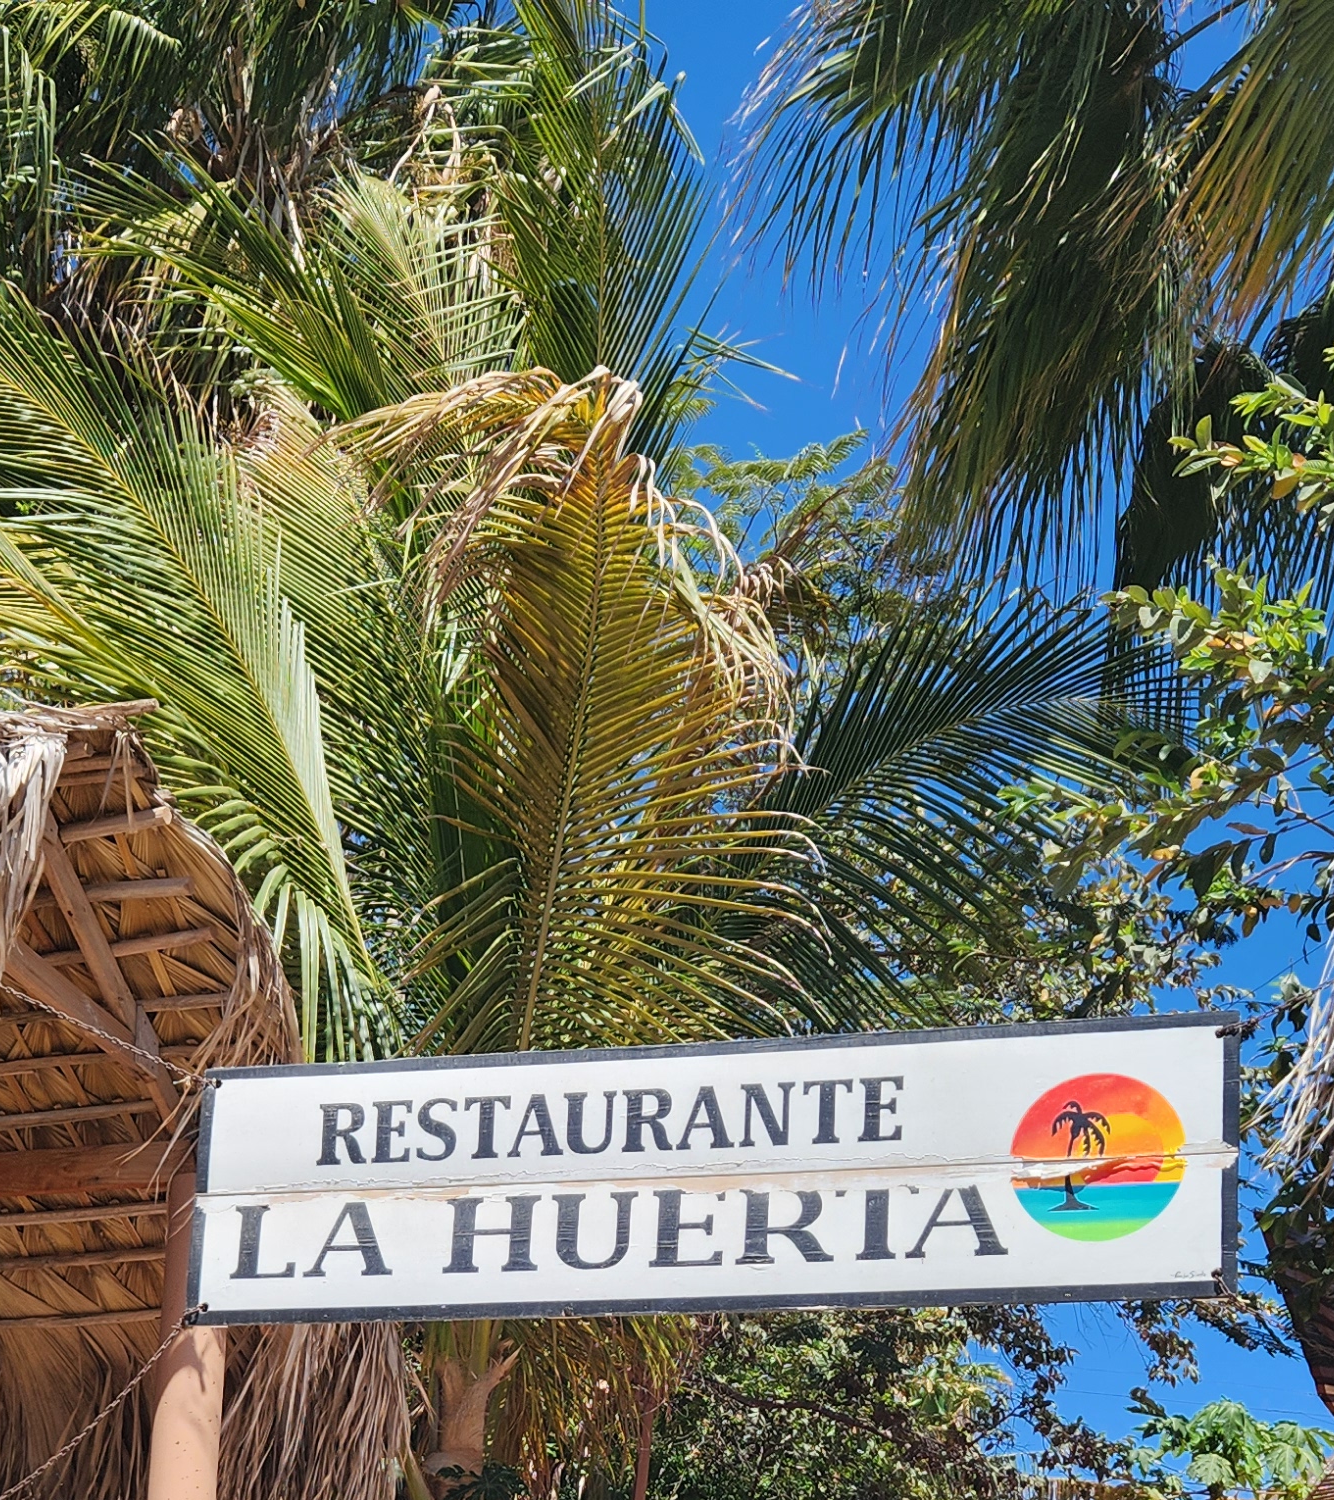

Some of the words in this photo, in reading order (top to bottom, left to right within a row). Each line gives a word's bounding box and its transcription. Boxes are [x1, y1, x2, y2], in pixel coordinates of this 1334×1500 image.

[316, 1075, 904, 1166] RESTAURANTE
[229, 1200, 393, 1279] LA
[442, 1184, 1009, 1272] HUERTA
